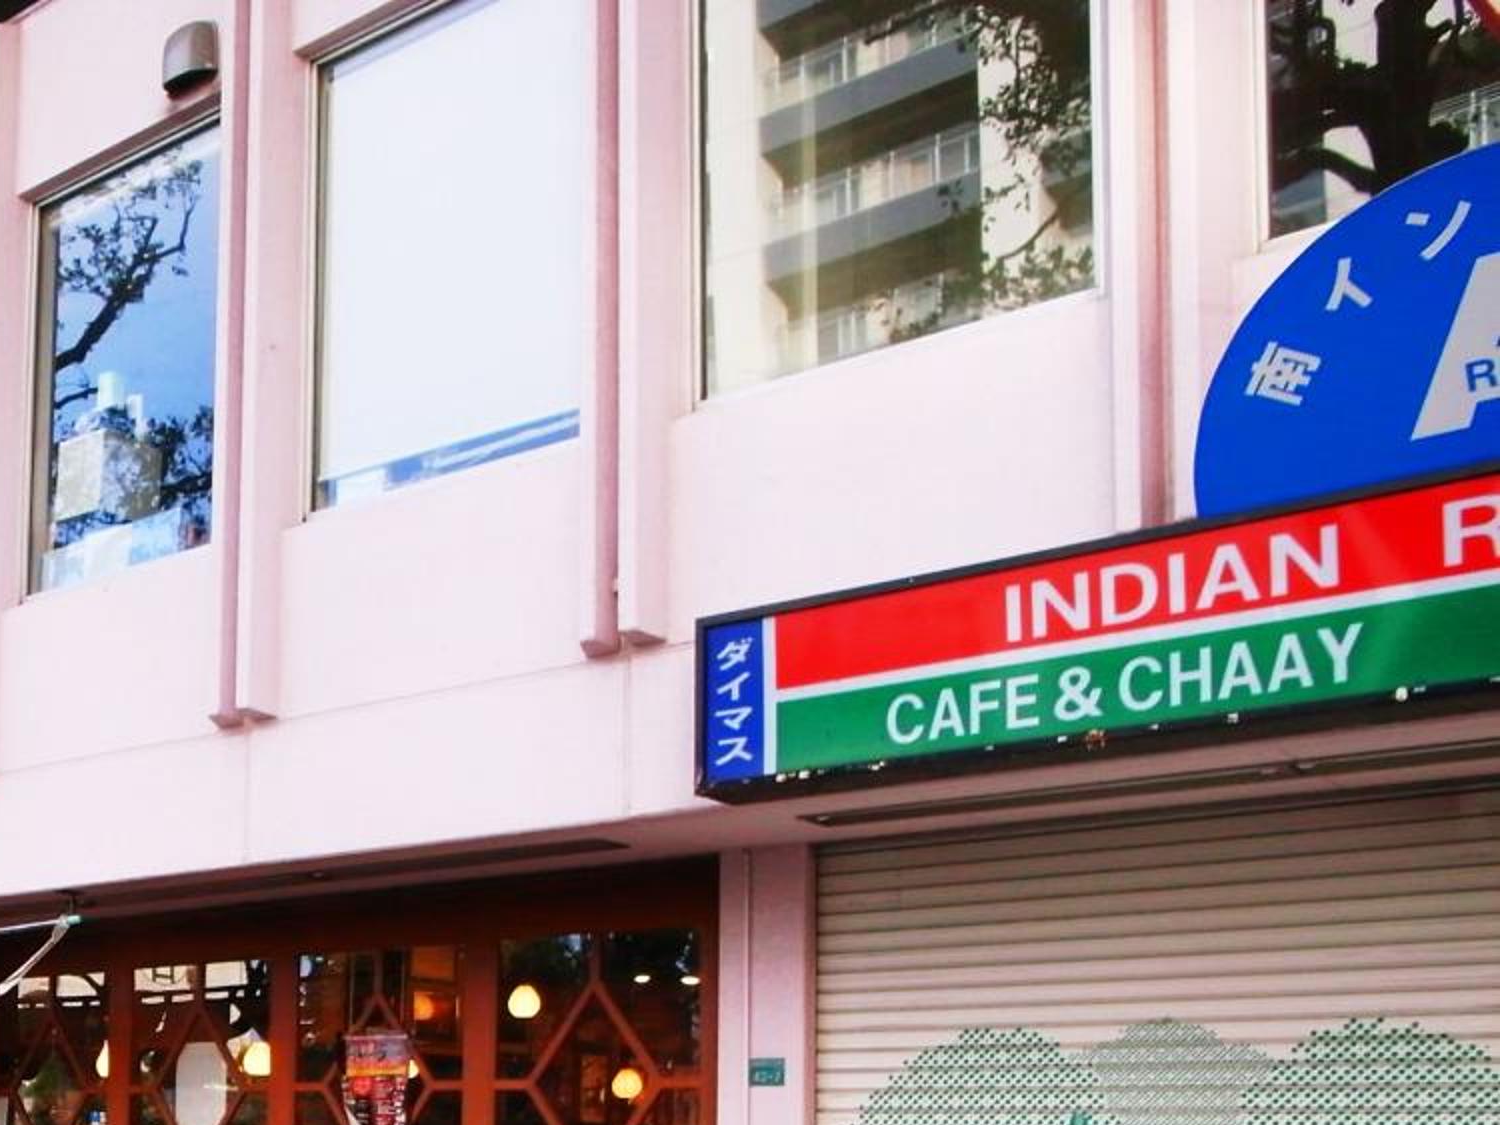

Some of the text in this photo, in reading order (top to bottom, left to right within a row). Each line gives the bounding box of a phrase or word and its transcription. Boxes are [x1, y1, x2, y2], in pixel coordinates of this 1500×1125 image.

[1007, 524, 1338, 643] INDIAN
[714, 636, 754, 767] ダイマス
[886, 622, 1363, 744] CAFE & CHAAY
